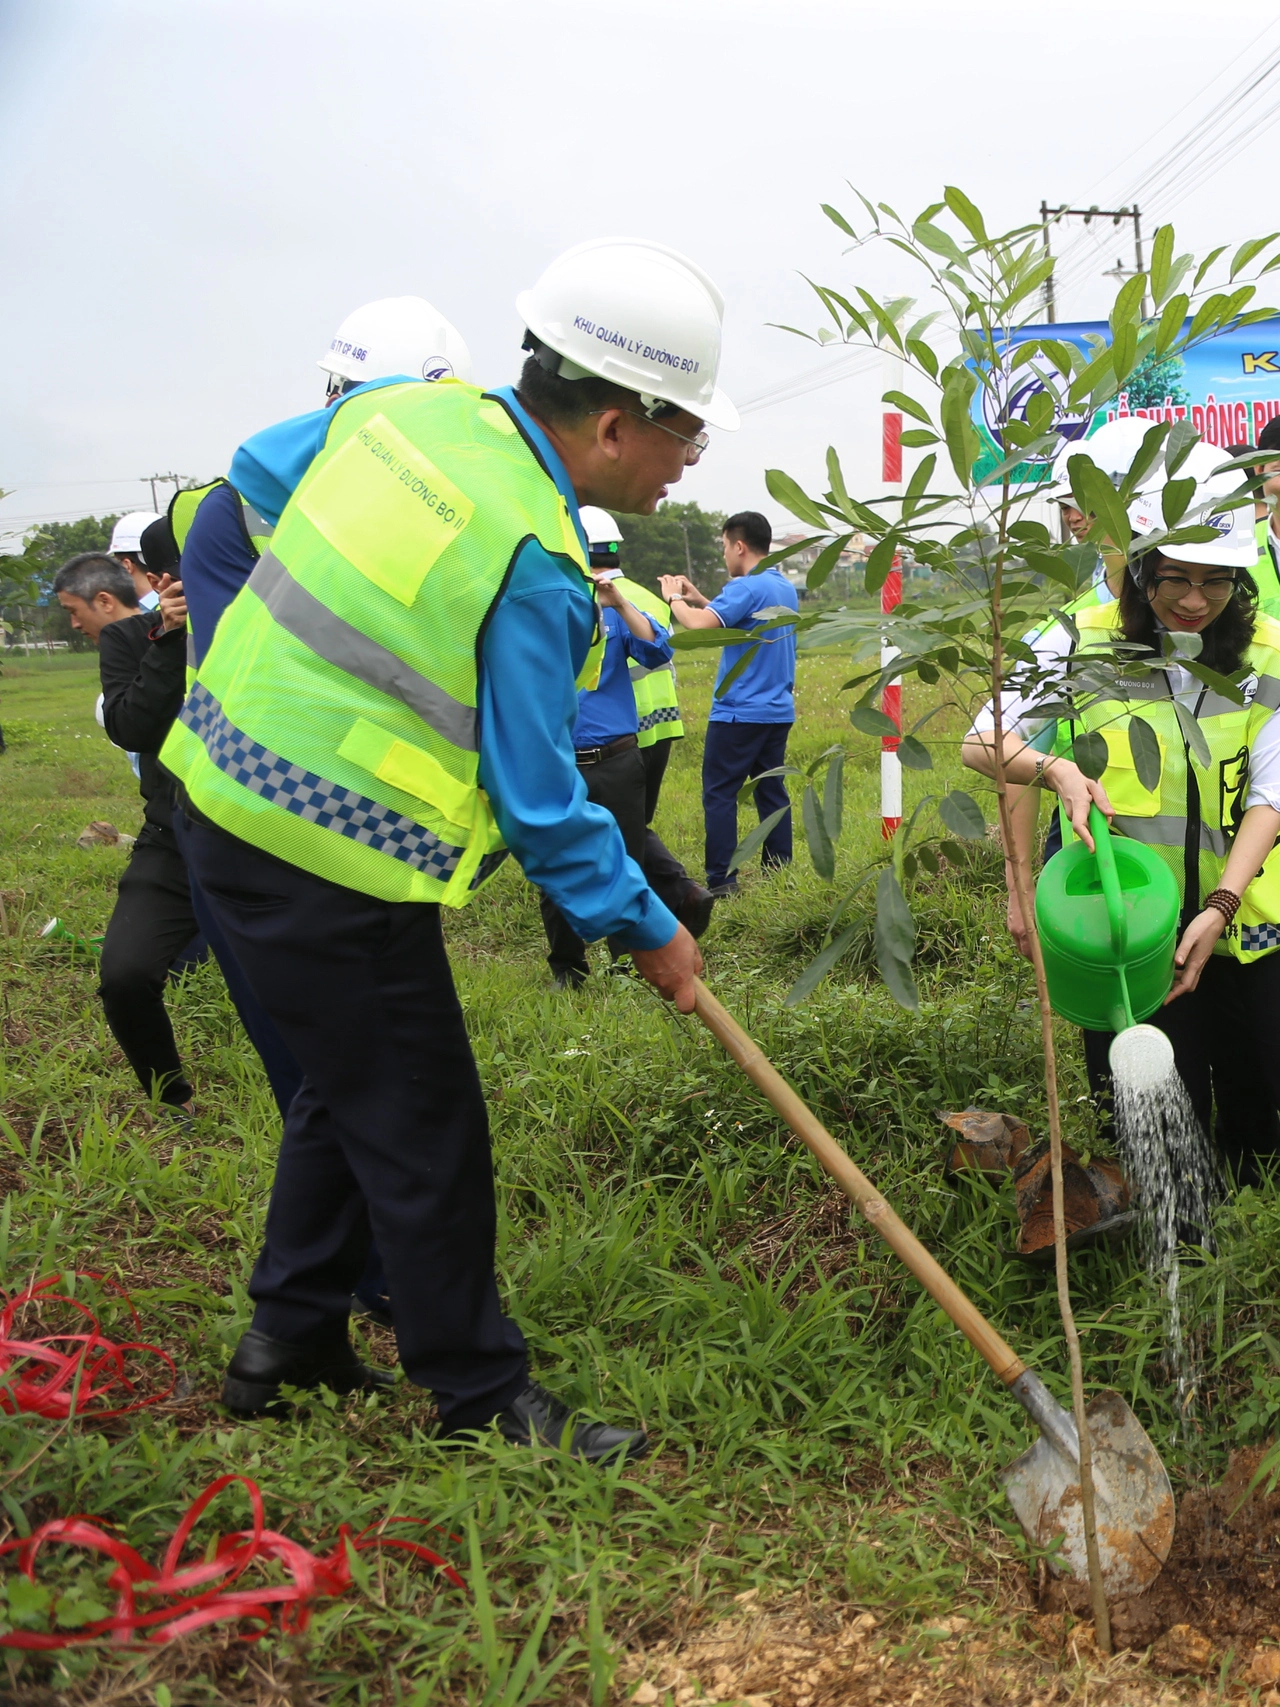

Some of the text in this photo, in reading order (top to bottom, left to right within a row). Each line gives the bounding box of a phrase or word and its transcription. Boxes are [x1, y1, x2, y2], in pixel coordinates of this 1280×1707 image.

[573, 315, 596, 335] KHU
[596, 331, 628, 349] QUẢN
[627, 340, 643, 354] LÝ
[352, 346, 368, 361] 496
[356, 427, 377, 447] KHU
